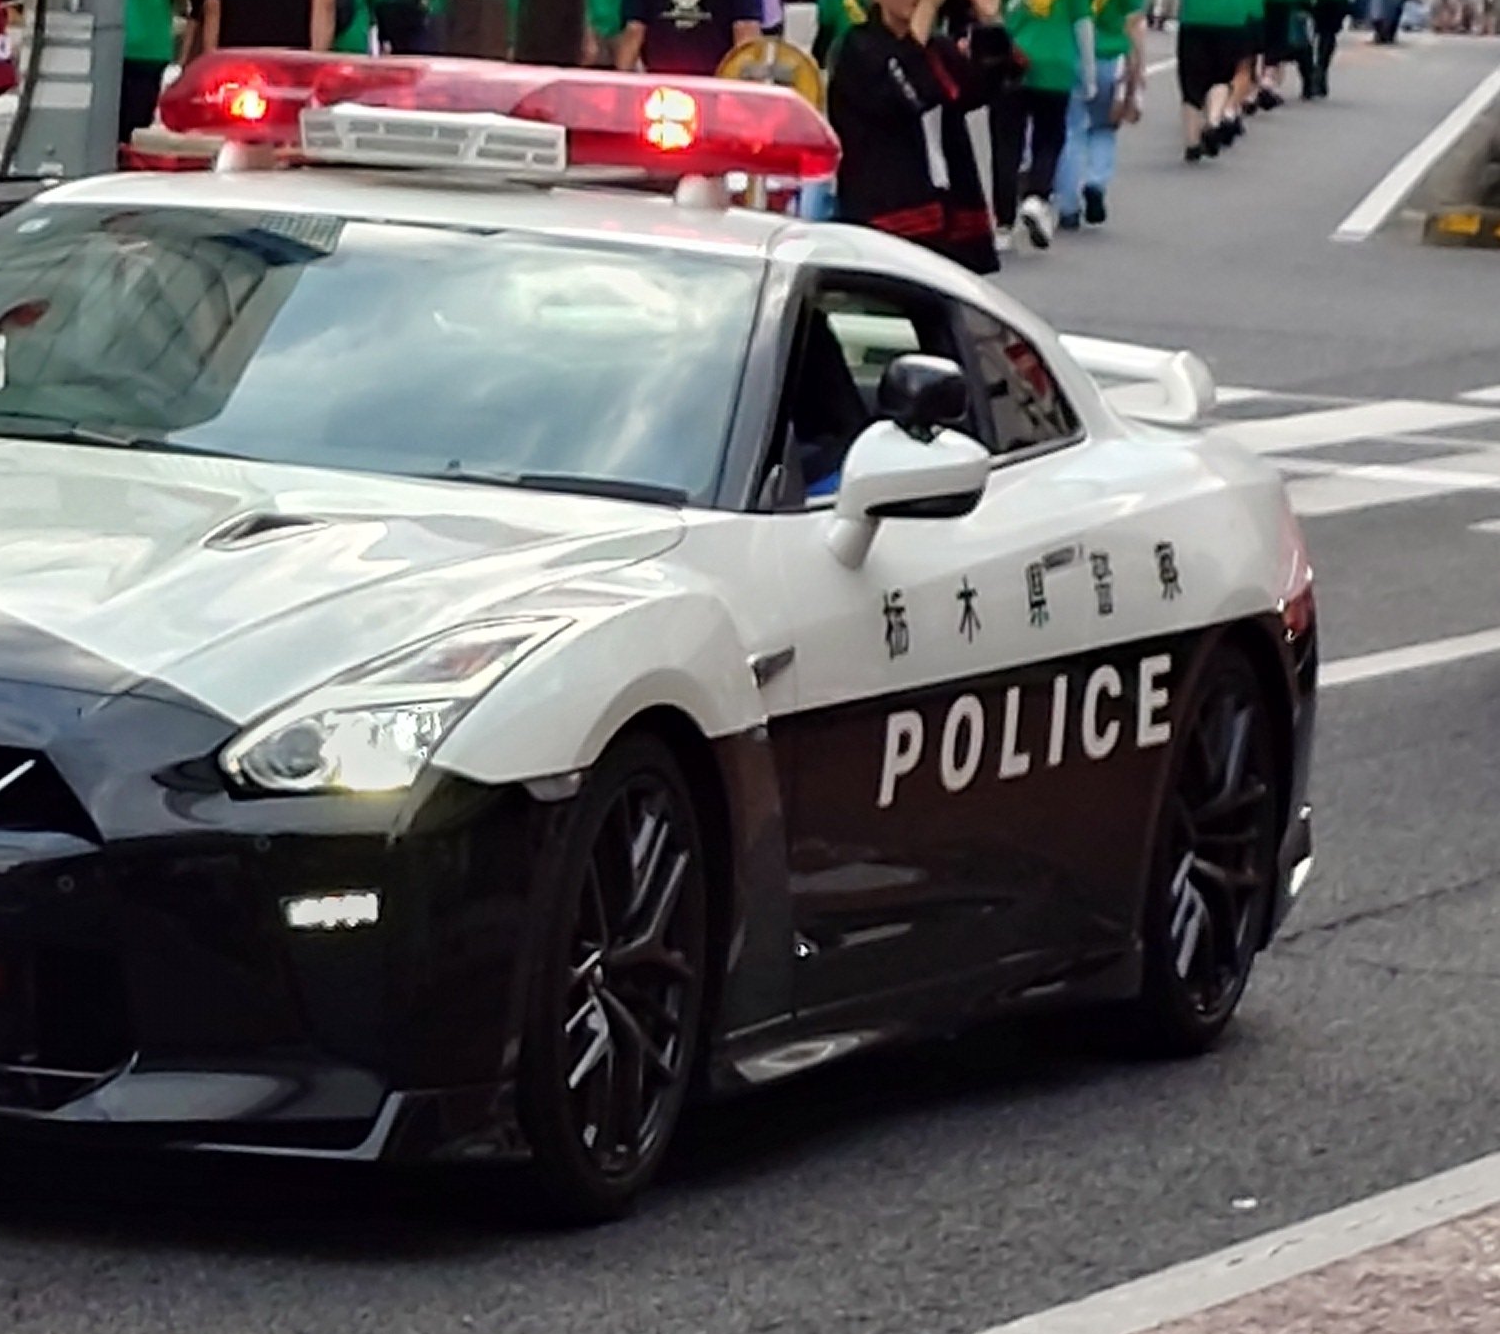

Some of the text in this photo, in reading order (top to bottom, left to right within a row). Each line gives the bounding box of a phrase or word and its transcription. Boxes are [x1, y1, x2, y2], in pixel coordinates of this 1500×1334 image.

[882, 540, 1182, 660] 栃木県警察
[876, 653, 1172, 808] POLICE
